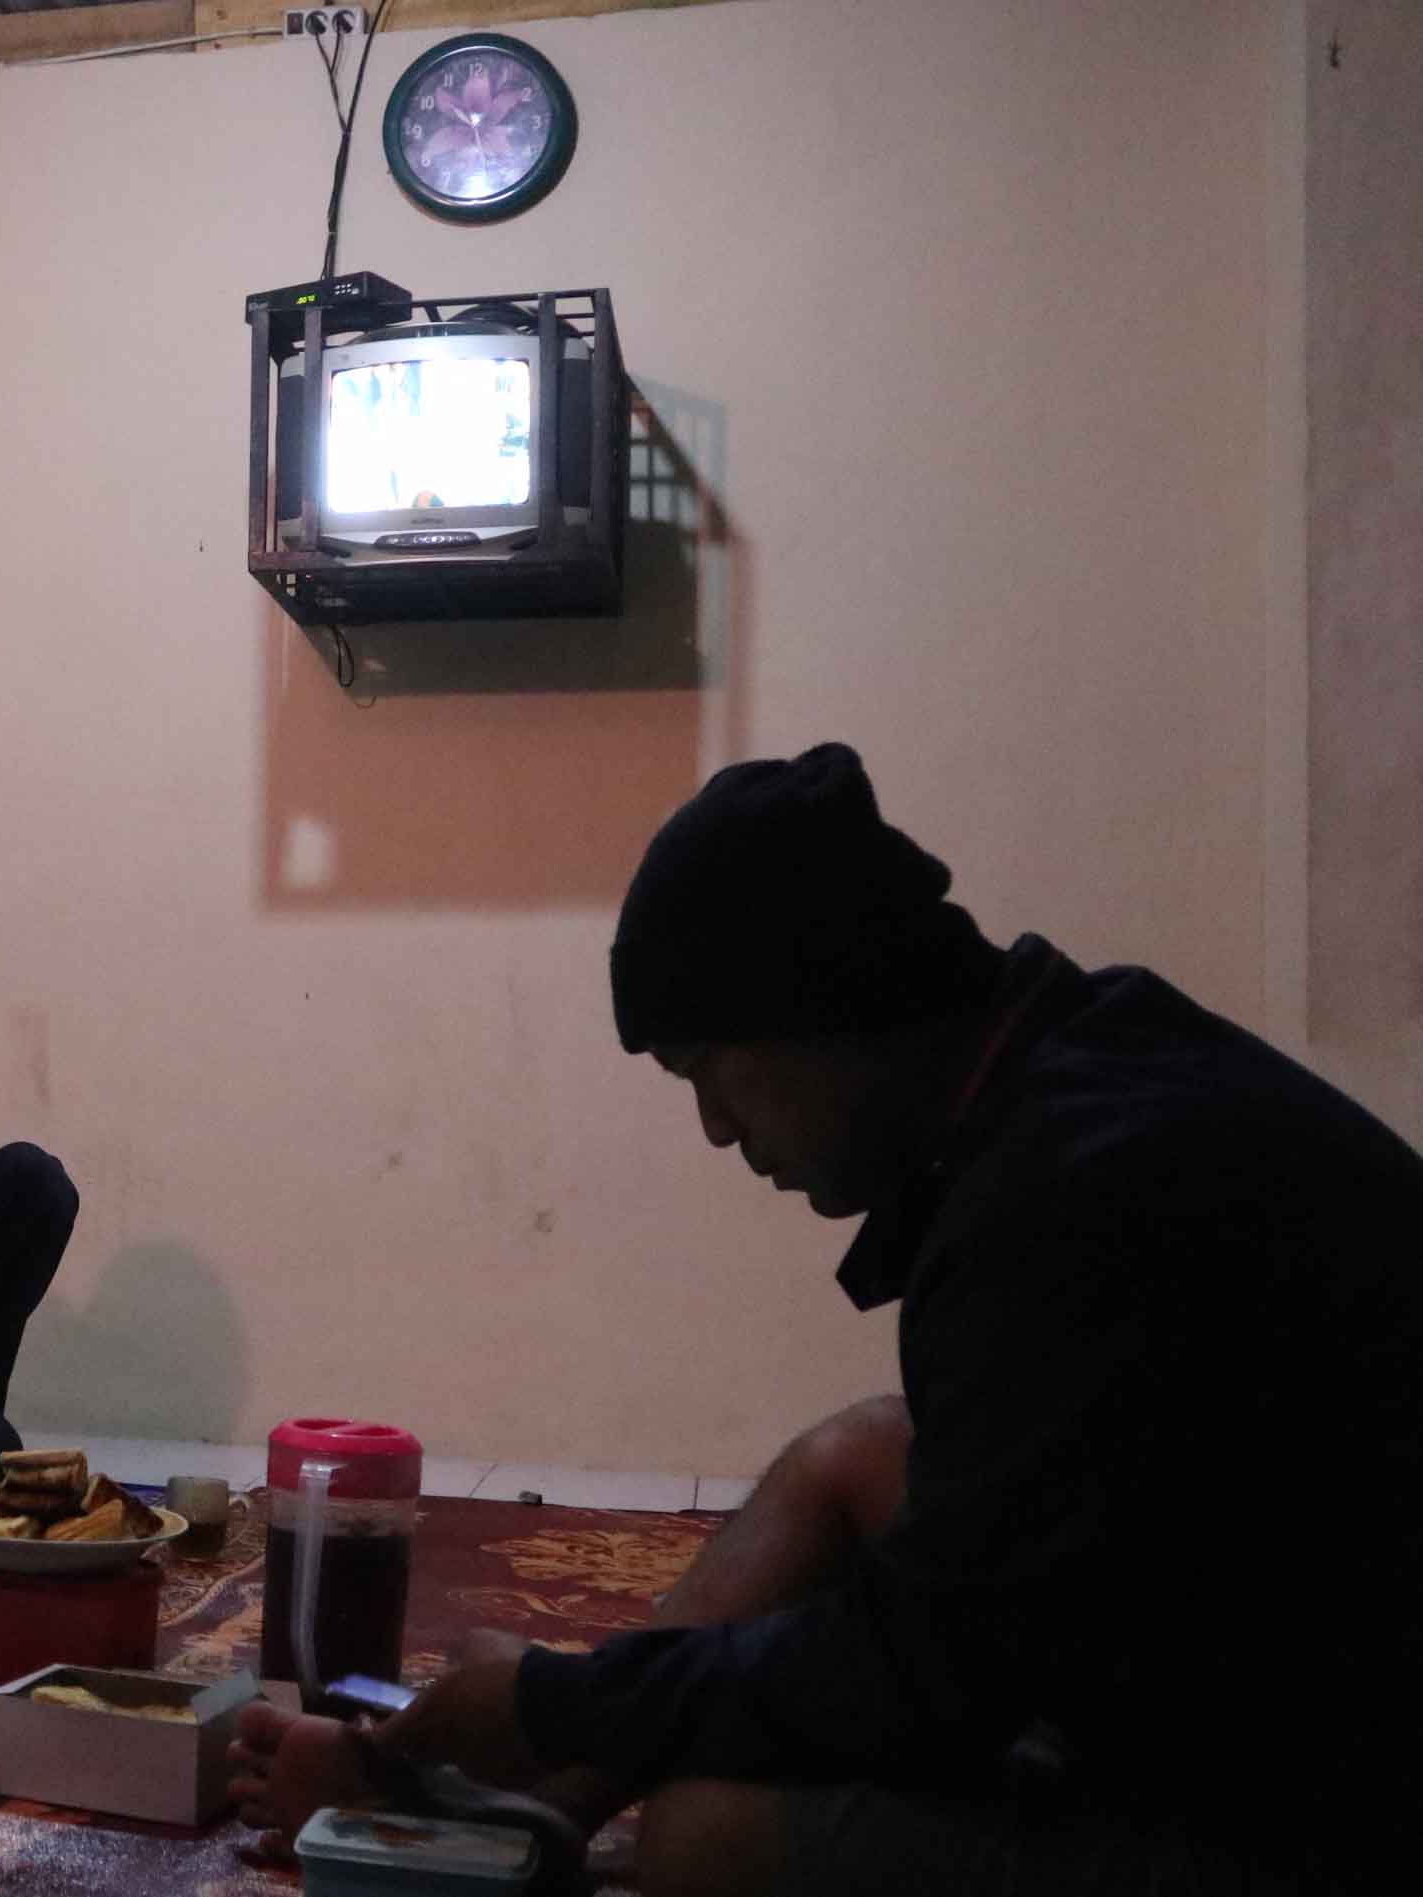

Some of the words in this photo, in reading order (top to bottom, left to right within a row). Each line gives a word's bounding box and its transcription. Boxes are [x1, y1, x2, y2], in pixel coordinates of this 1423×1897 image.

[469, 62, 483, 76] 12
[444, 74, 453, 87] 11
[521, 87, 532, 102] 2
[420, 95, 435, 110] 10
[531, 115, 541, 129] 3
[412, 124, 423, 140] 9
